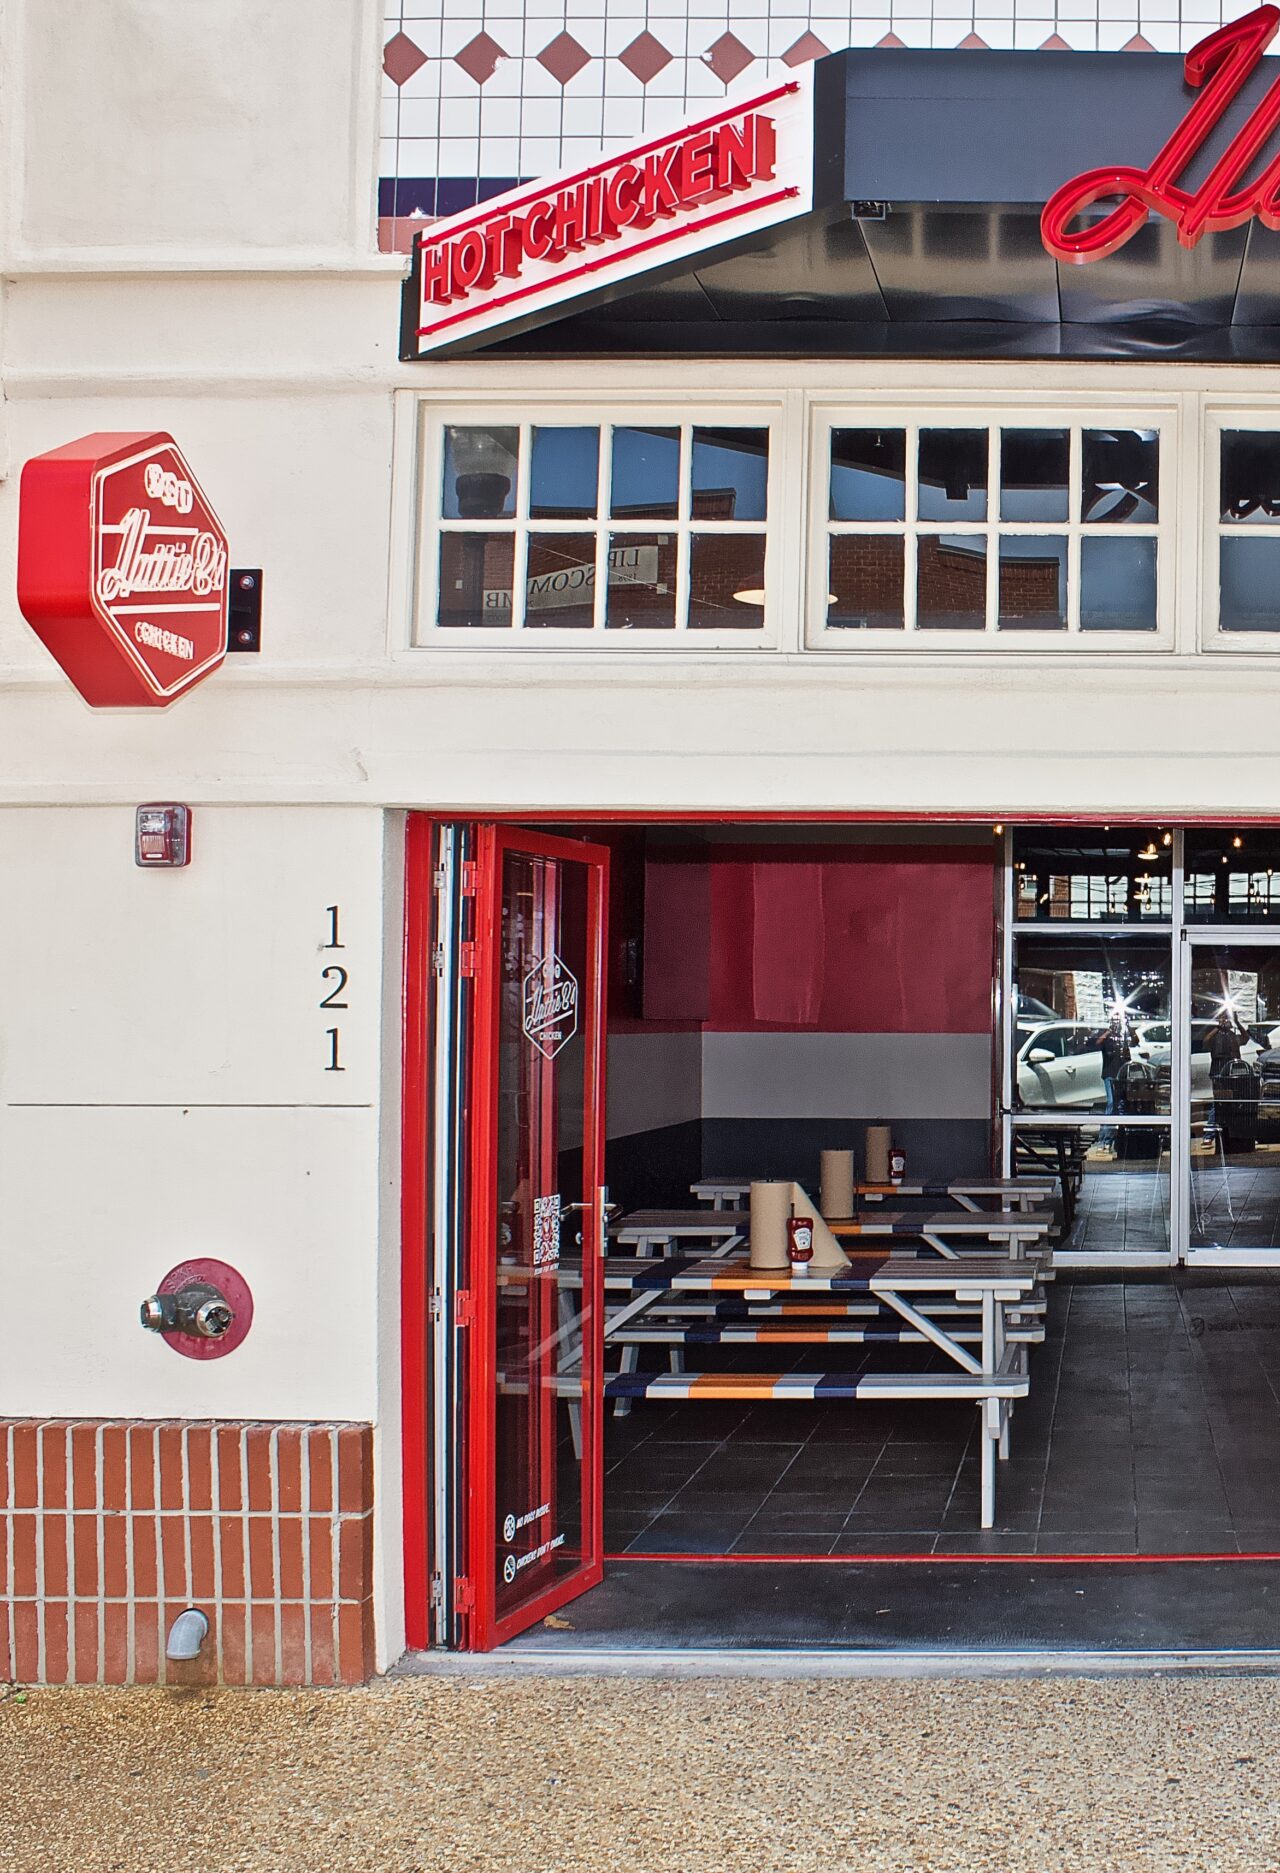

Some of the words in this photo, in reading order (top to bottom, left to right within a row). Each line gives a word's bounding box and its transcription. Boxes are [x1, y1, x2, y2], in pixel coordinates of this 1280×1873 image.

[424, 214, 522, 306] HOT
[521, 114, 776, 264] CHICKEN
[134, 621, 194, 660] CHICKEN
[319, 905, 349, 1071] 121
